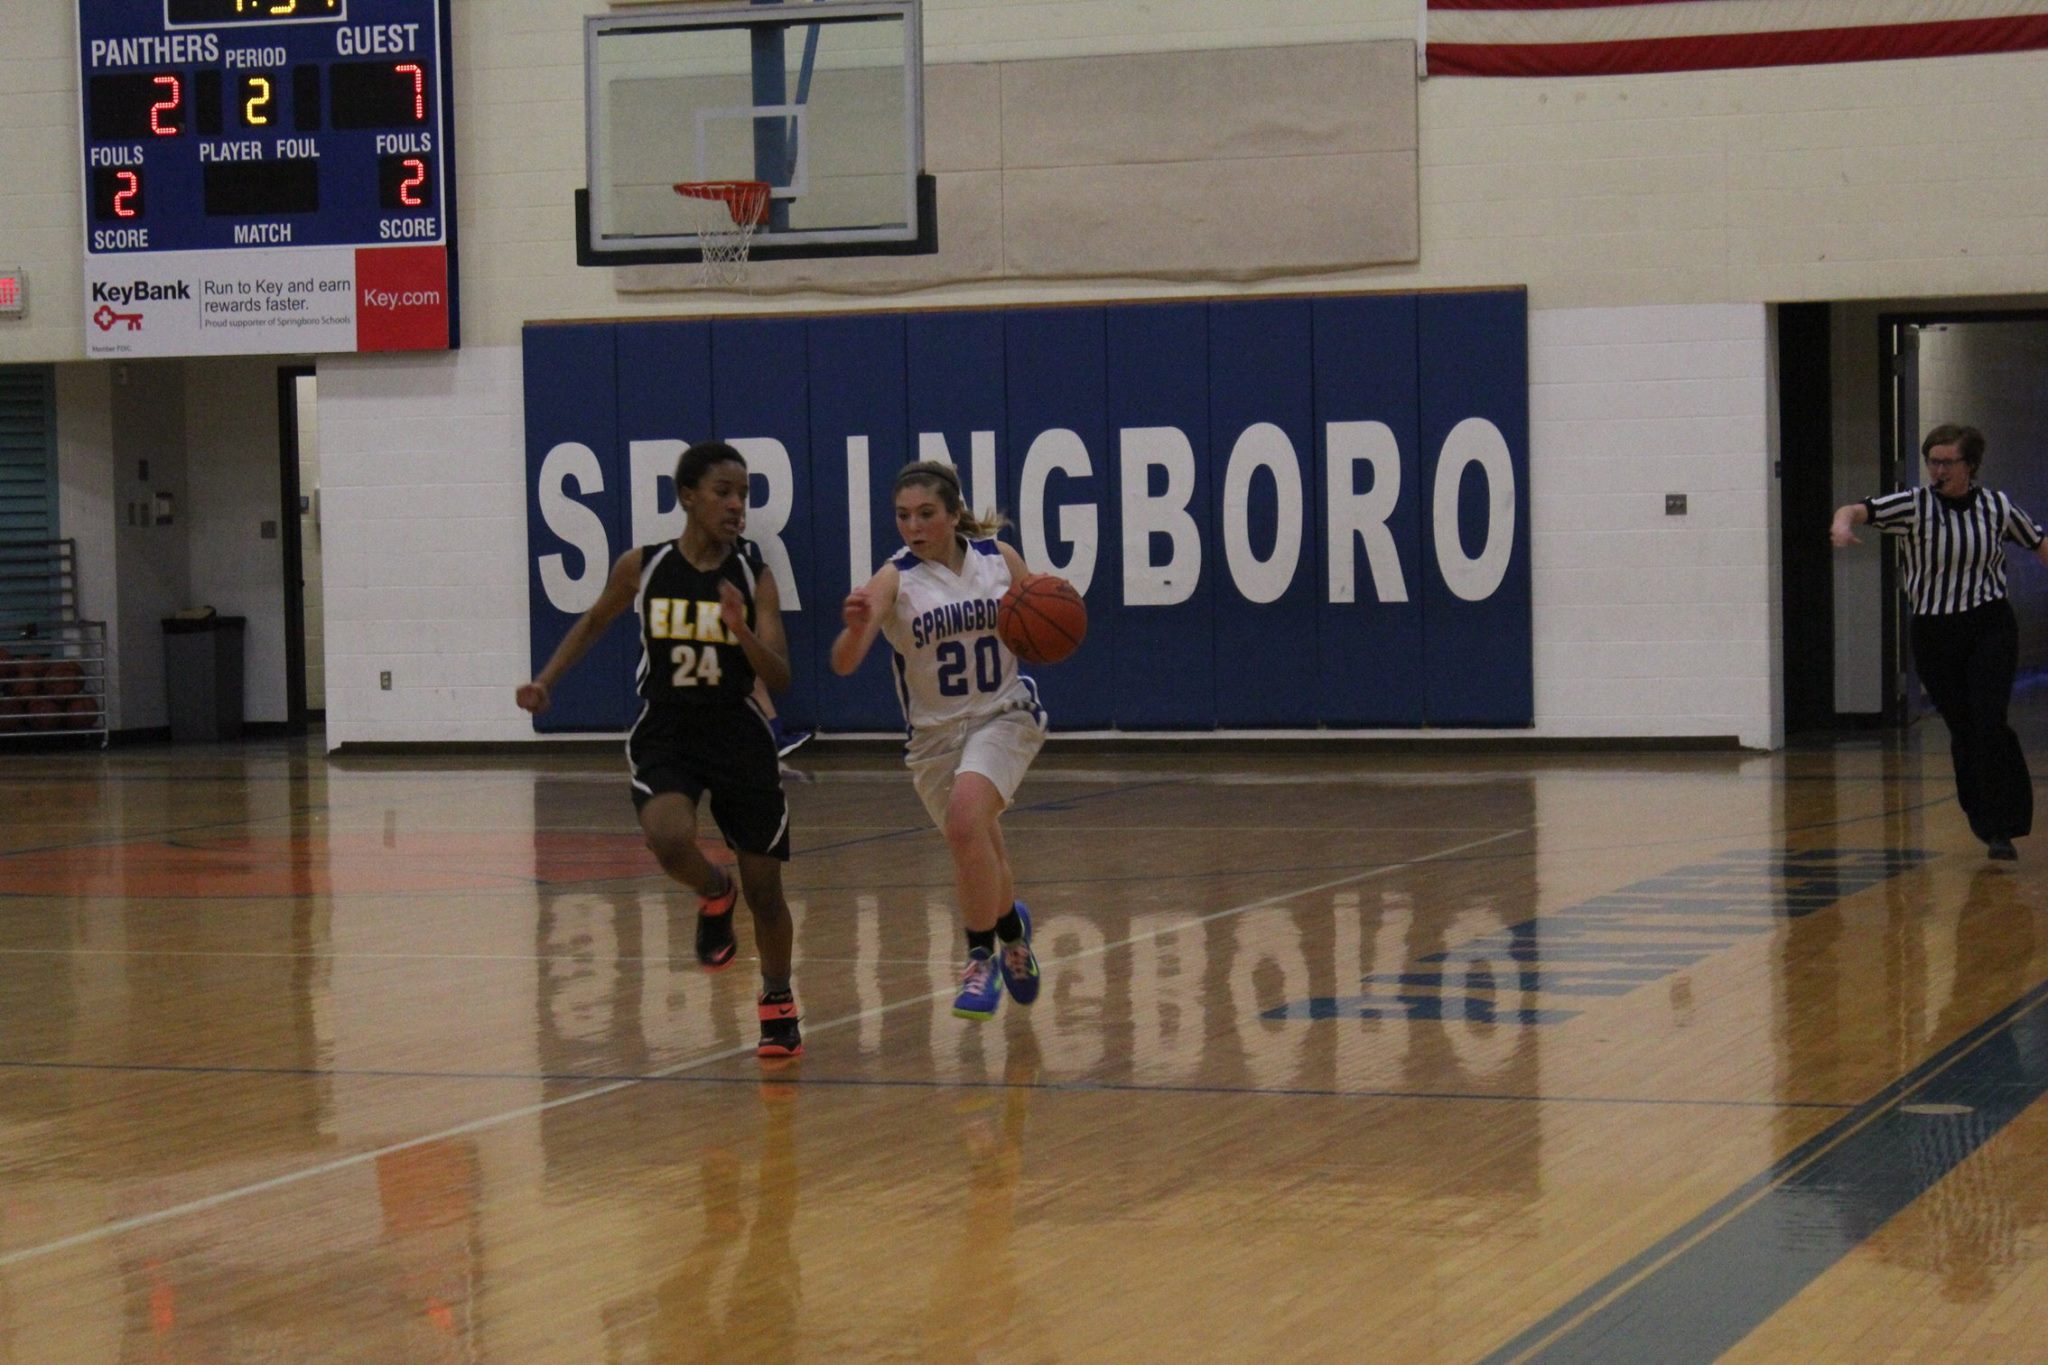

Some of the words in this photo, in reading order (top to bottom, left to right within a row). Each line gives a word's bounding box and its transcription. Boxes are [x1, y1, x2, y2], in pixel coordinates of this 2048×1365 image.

[91, 34, 220, 67] PANTHERS
[336, 23, 419, 55] GUEST
[225, 47, 287, 69] PERIOD
[246, 78, 270, 125] 2
[395, 64, 423, 119] 7
[150, 76, 180, 136] 2
[90, 146, 144, 166] FOULS
[200, 141, 262, 162] PLAYER
[276, 139, 320, 158] FOUL
[376, 133, 431, 154] FOULS
[114, 171, 137, 217] 2
[401, 159, 424, 206] 2
[94, 229, 149, 249] SCORE
[234, 223, 292, 244] MATCH
[379, 218, 436, 239] SCORE
[92, 280, 191, 305] KeyBank
[204, 280, 233, 295] Run
[238, 281, 251, 294] to
[256, 279, 283, 297] Key
[288, 278, 314, 293] and
[319, 280, 351, 292] earn
[364, 288, 440, 310] Key.com
[204, 298, 261, 313] rewards
[265, 297, 309, 311] faster.
[204, 319, 227, 328] Proud
[229, 319, 265, 328] supporter
[267, 317, 276, 326] of
[277, 316, 319, 327] Springboro
[321, 315, 350, 325] Schools
[650, 597, 748, 646] ELK
[912, 599, 1001, 648] SPRINGBO
[671, 645, 722, 687] 24
[936, 636, 1002, 697] 20
